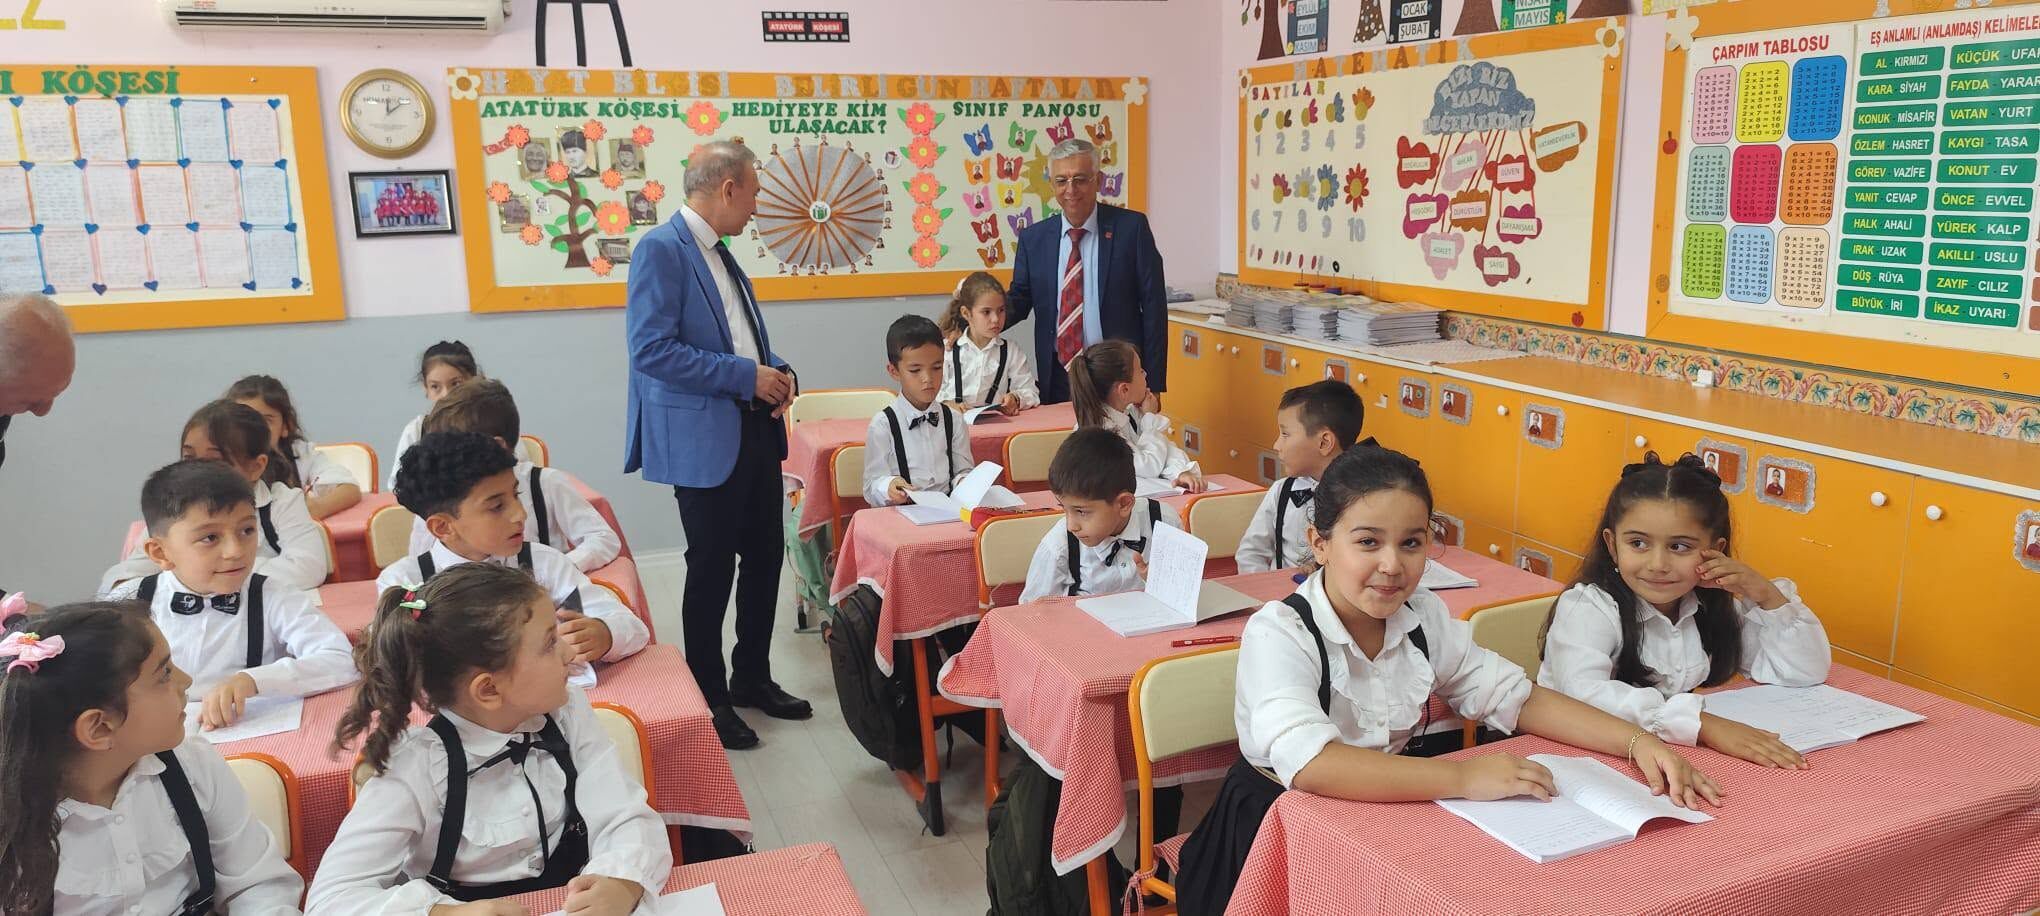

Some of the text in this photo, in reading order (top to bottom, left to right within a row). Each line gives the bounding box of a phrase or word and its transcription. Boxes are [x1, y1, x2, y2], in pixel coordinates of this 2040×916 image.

[1402, 3, 1426, 16] OCAK
[769, 22, 804, 31] ATATÜRK
[1515, 11, 1549, 27] MAYIS
[1870, 31, 1880, 47] EŞ
[1883, 26, 1921, 43] ANLAMLI
[1922, 20, 1982, 43] (ANLAMDAŞ)
[1712, 34, 1830, 64] ÇARPIM TABLOSU
[1956, 47, 2040, 64] KÜÇÜK UFA
[1875, 54, 1928, 69] AL KIRMIZI
[41, 65, 180, 98] KÖŞESİ
[1867, 81, 1927, 95] KARA SİYAH
[1950, 76, 2040, 91] FAYDA YARAR
[1252, 81, 1325, 100] SAYILAR
[481, 98, 680, 120] ATATÜRK KÖŞESİ
[732, 100, 887, 117] HEDİYEYE KİM
[953, 101, 1101, 117] SINIF PANOSU
[1950, 106, 2033, 120] VATAN YURT
[1858, 109, 1935, 124] KONUK MİSAFİR
[1255, 124, 1366, 156] 1 2 3 4 5
[1854, 139, 1930, 151] ÖZLEM HASRET
[1948, 136, 2028, 148] KAYGI TASA
[1855, 165, 1926, 178] GÖREV VAZİFE
[1948, 164, 2018, 176] KONUT EV
[1854, 192, 1917, 203] YANIT CEVAP
[1941, 193, 2026, 207] ÖNCE EVVEL
[1251, 209, 1366, 242] 6 7 8 9 10
[1854, 217, 1912, 231] HALK AHALİ
[1937, 221, 2021, 235] YÜREK KALP
[1853, 244, 1907, 257] IRAK UZAK
[1937, 249, 2018, 263] AKILLI USLU
[1852, 269, 1904, 284] DÜŞ RÜYA
[1936, 278, 2009, 293] ZAYIF CILIZ
[1851, 296, 1903, 311] BÜYÜK İRİ
[1933, 302, 2006, 319] İKAZ UYARI
